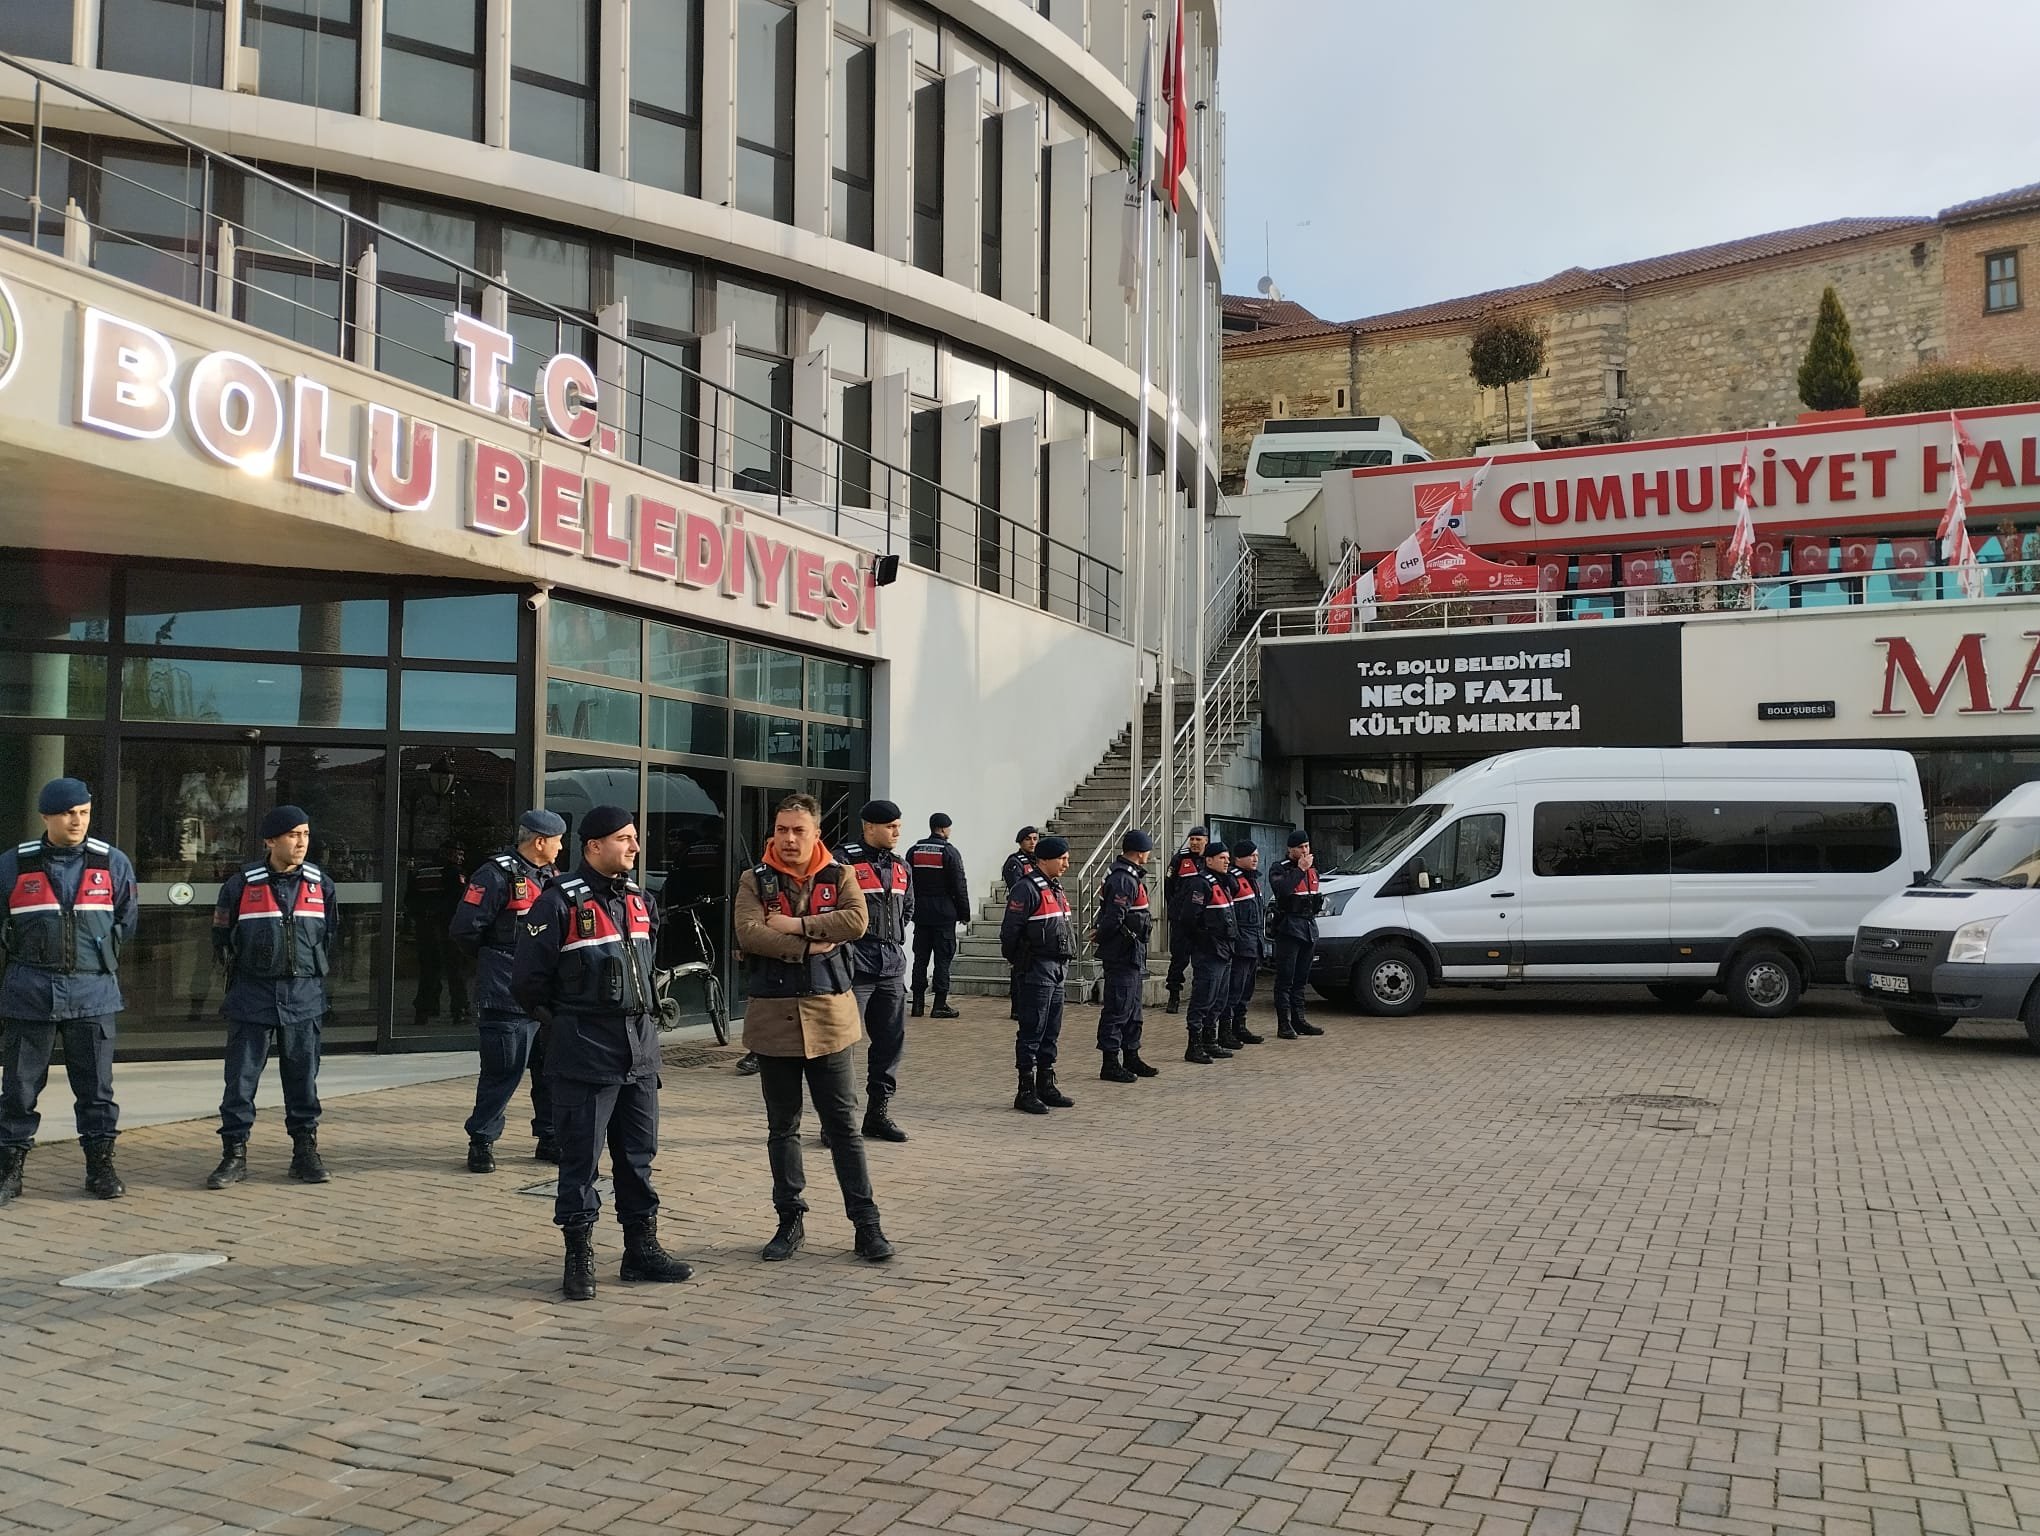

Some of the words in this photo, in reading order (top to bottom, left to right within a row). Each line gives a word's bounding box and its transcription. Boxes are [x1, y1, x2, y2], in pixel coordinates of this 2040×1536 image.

[450, 311, 617, 455] T.C.
[76, 304, 438, 512] BOLU
[466, 437, 877, 634] BELEDİYESİ
[1499, 447, 1897, 527] CUMHURİYET
[1400, 557, 1420, 570] CHP
[1333, 610, 1349, 621] CHP
[1357, 660, 1393, 677] T.C.
[1396, 658, 1450, 675] BOLU
[1454, 649, 1571, 673] BELEDİYESİ
[1360, 675, 1457, 708] NECİP
[1464, 677, 1563, 704] FAZIL
[1350, 711, 1452, 737] KÜLTÜR
[1457, 704, 1581, 734] MERKEZİ
[1767, 707, 1792, 715] BOLU
[1792, 704, 1826, 716] ŞUBESİ
